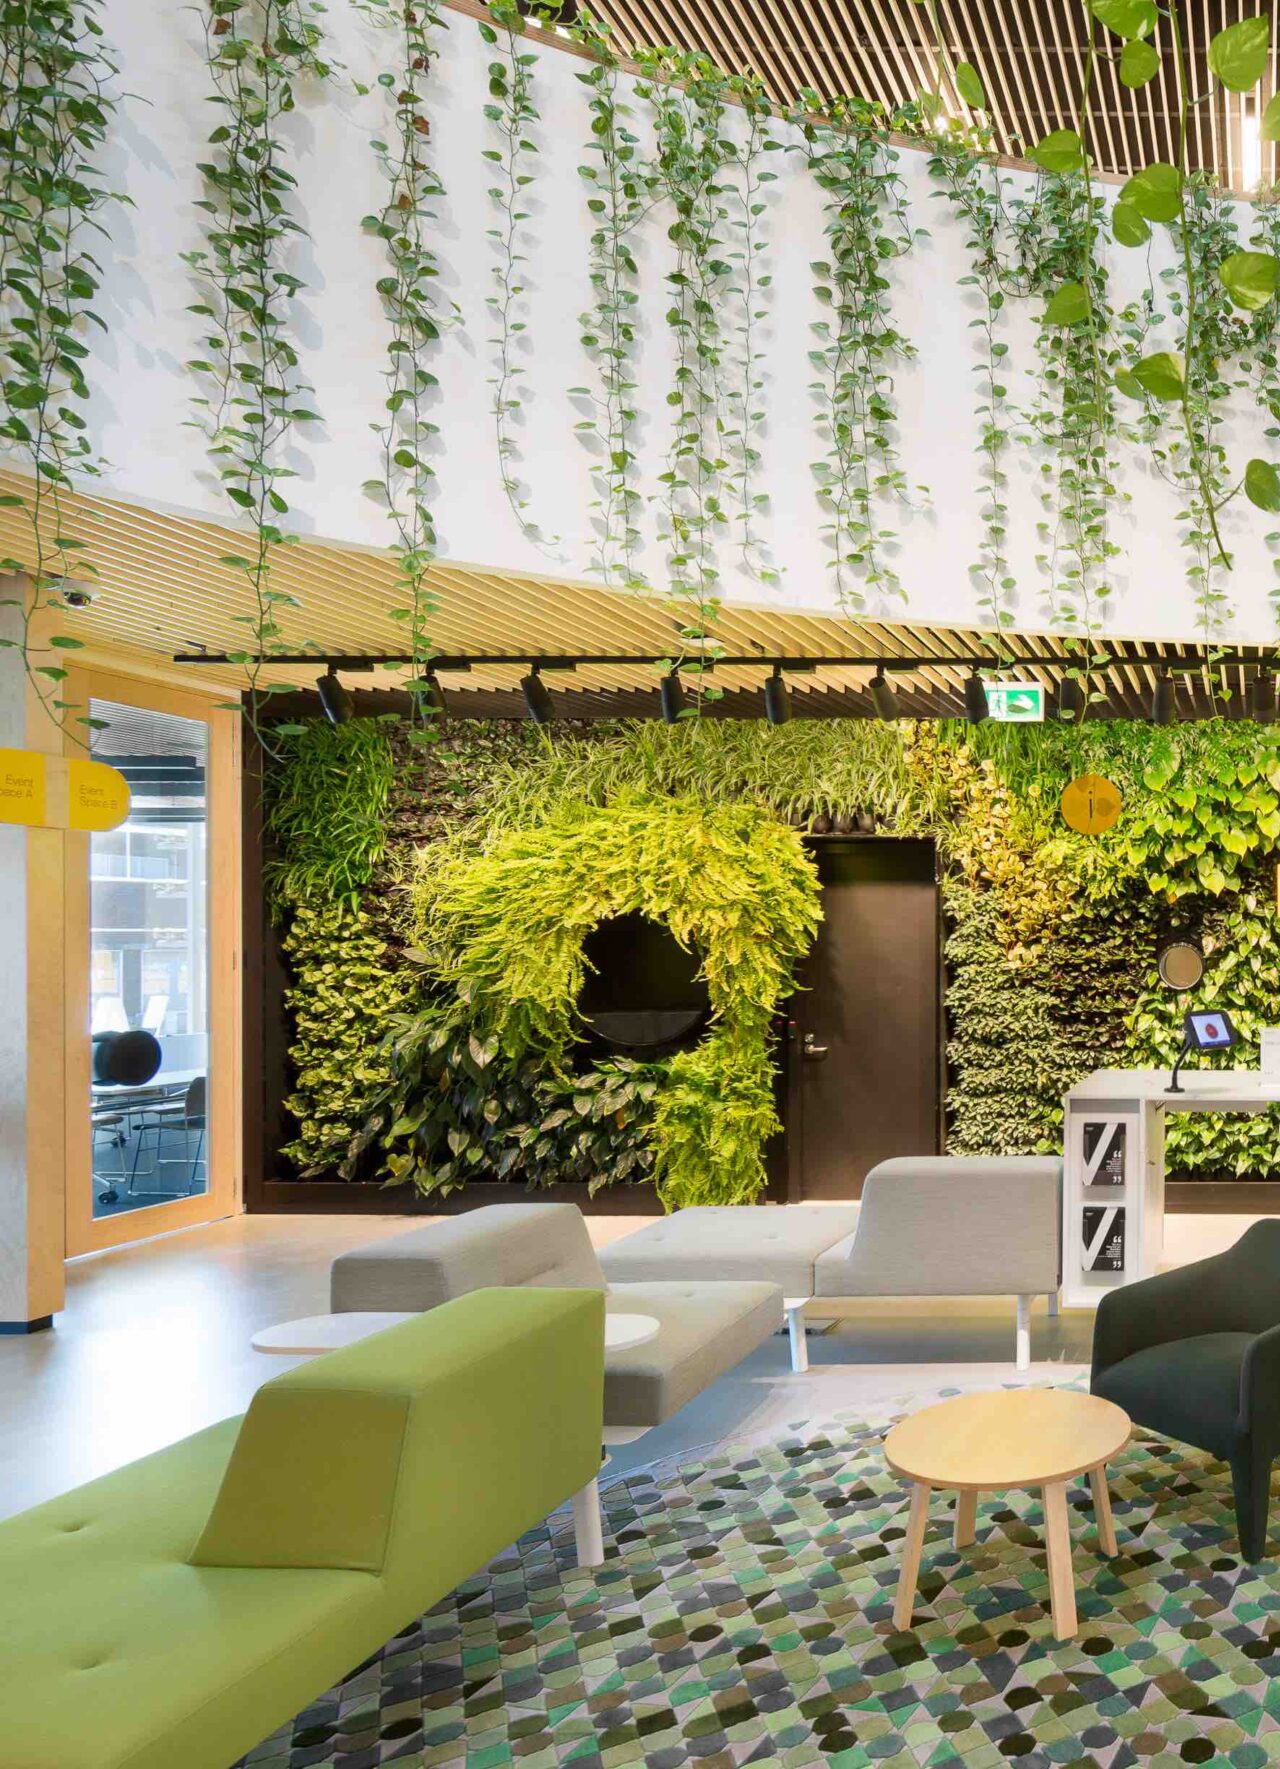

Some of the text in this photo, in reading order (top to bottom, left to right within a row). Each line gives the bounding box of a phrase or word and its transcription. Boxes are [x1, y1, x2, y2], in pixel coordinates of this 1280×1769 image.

[5, 773, 33, 788] Event
[80, 784, 104, 796] Event
[80, 795, 110, 808] Space
